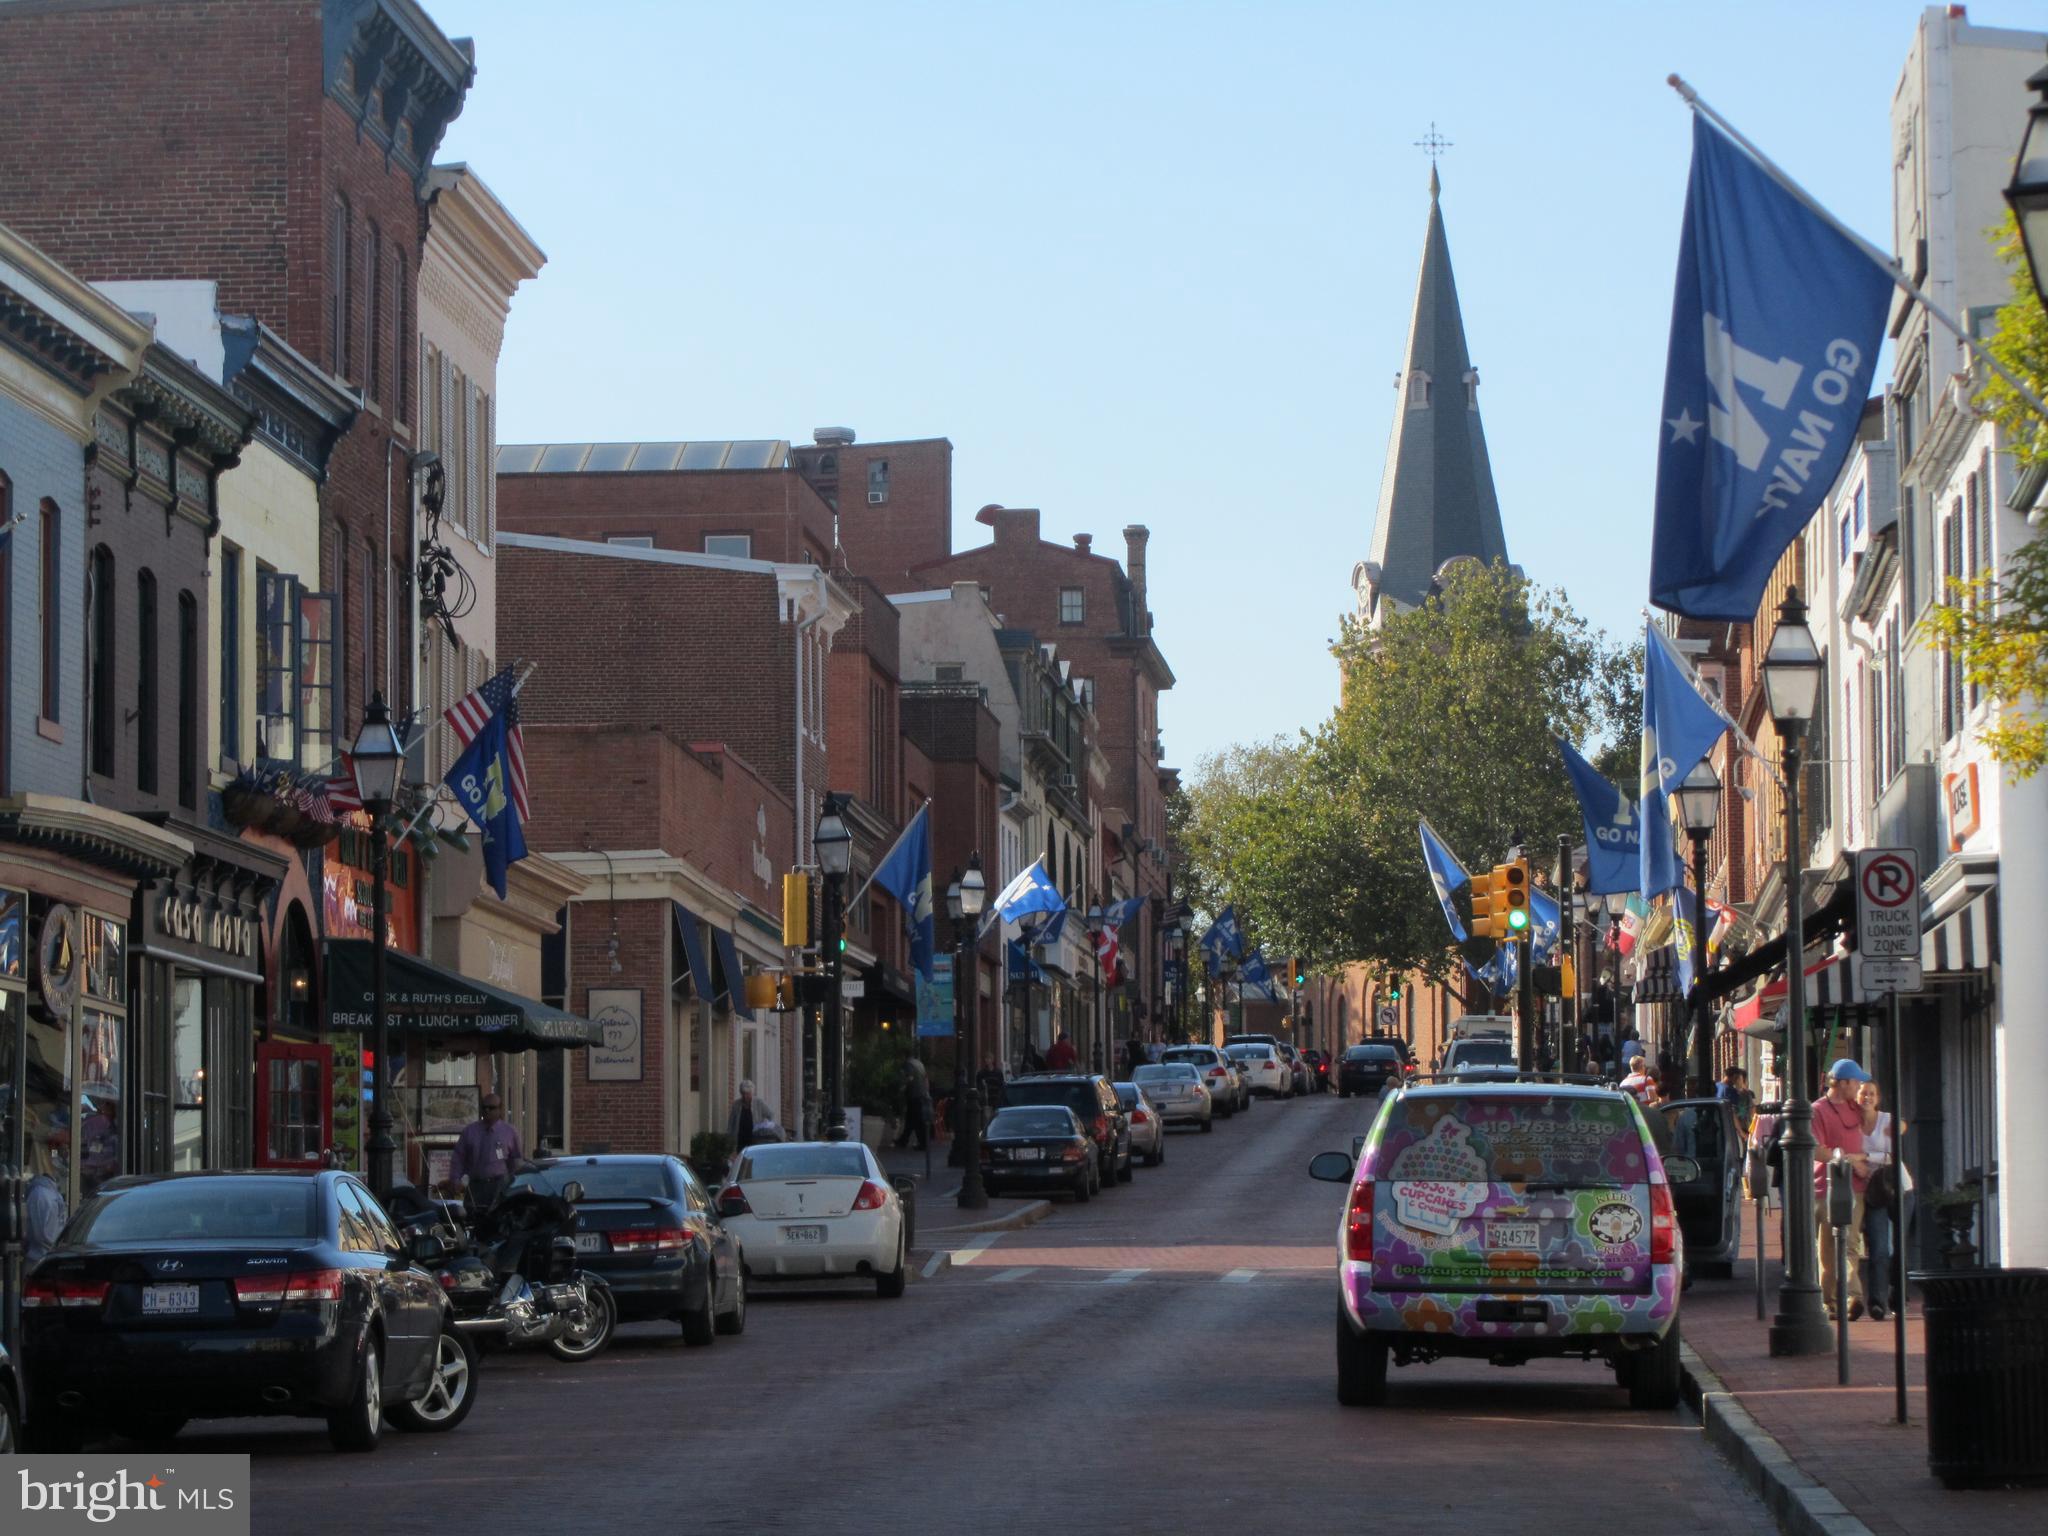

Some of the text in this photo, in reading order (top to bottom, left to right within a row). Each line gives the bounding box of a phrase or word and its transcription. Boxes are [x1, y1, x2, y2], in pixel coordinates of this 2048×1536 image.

[460, 774, 482, 804] GO
[1596, 826, 1621, 843] GO
[1869, 910, 1911, 922] TRUCK
[1867, 924, 1913, 937] LOADING
[1873, 939, 1907, 952] ZONE
[401, 993, 409, 1003] &
[412, 993, 451, 1003] RUTH'S
[454, 994, 488, 1005] DELLY
[332, 1012, 519, 1027] BREAKST LUNCH DINNER
[1400, 1186, 1468, 1212] CUPCAKES
